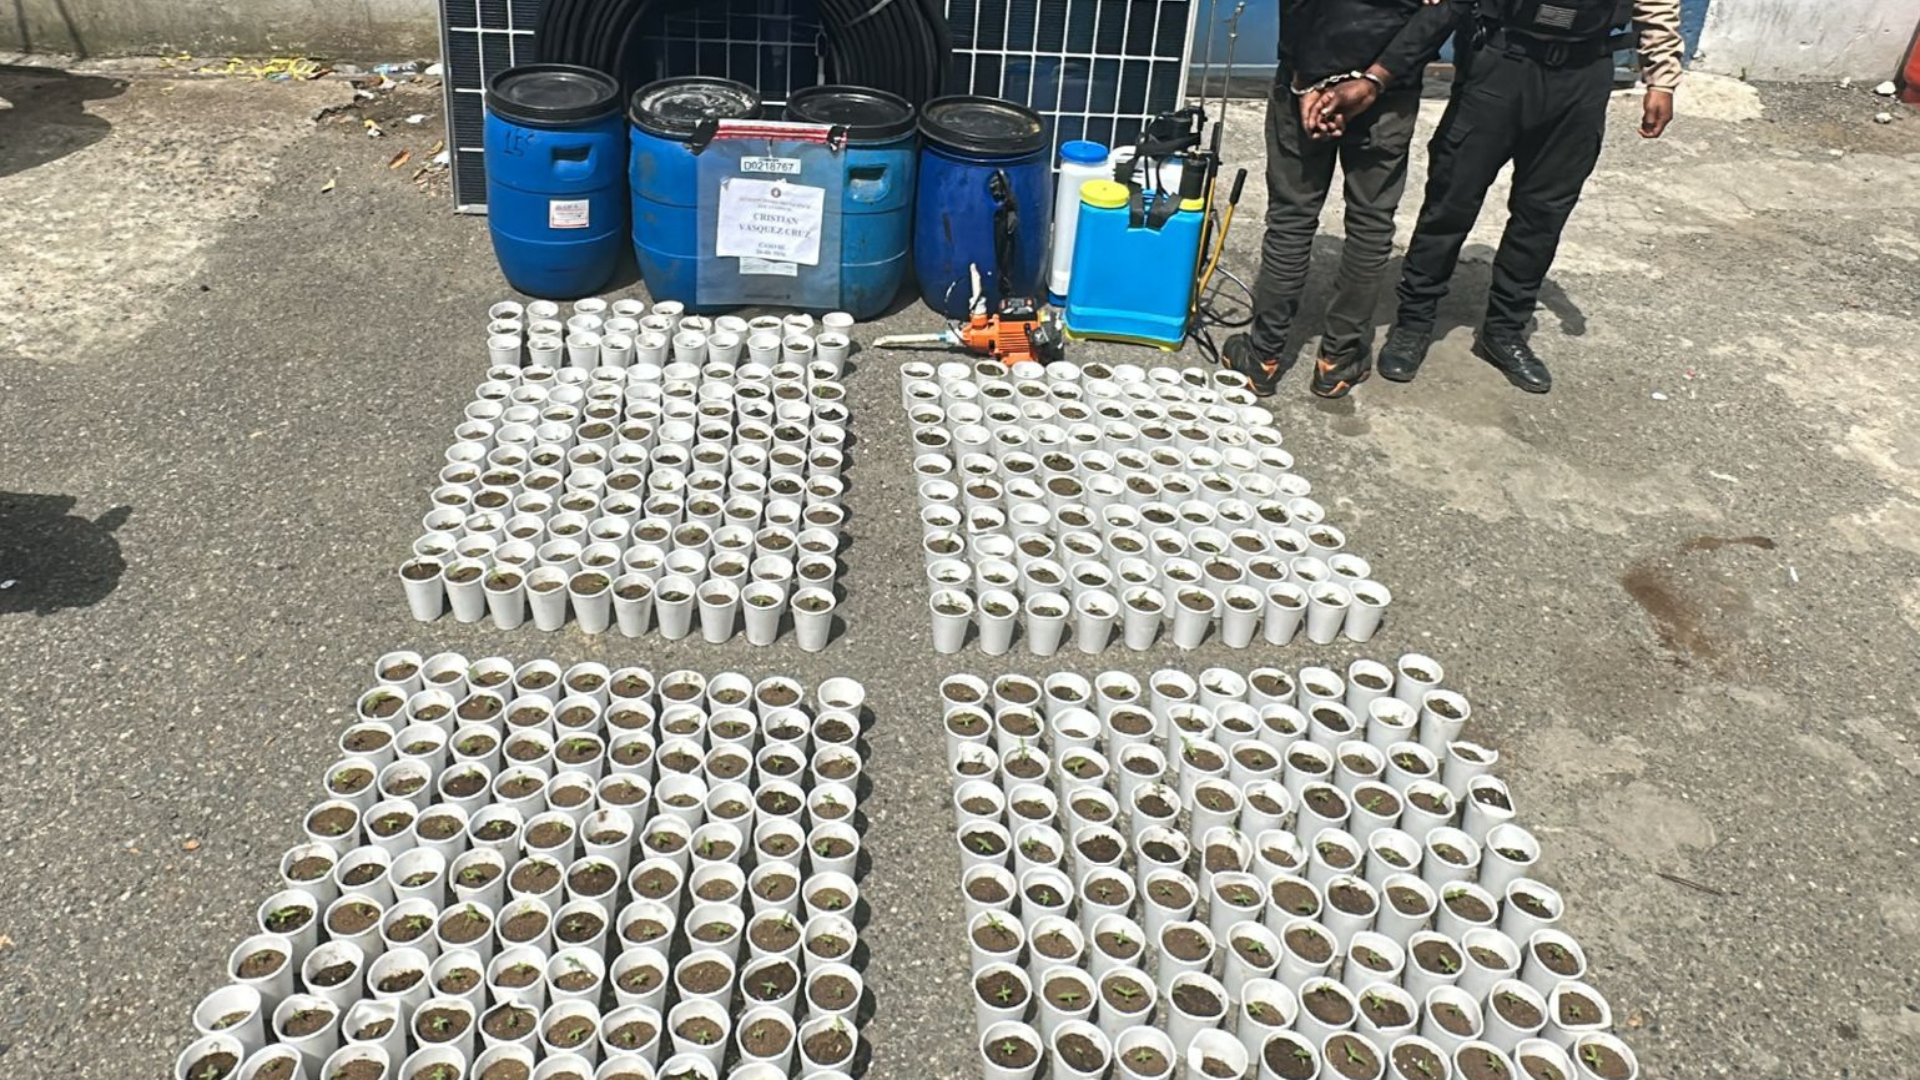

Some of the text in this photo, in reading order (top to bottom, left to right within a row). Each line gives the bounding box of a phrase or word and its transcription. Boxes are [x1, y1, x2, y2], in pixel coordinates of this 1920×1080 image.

[744, 161, 794, 171] D0218767
[753, 212, 798, 224] CRISTIAN
[739, 223, 811, 239] VASQUEZ CRUZ
